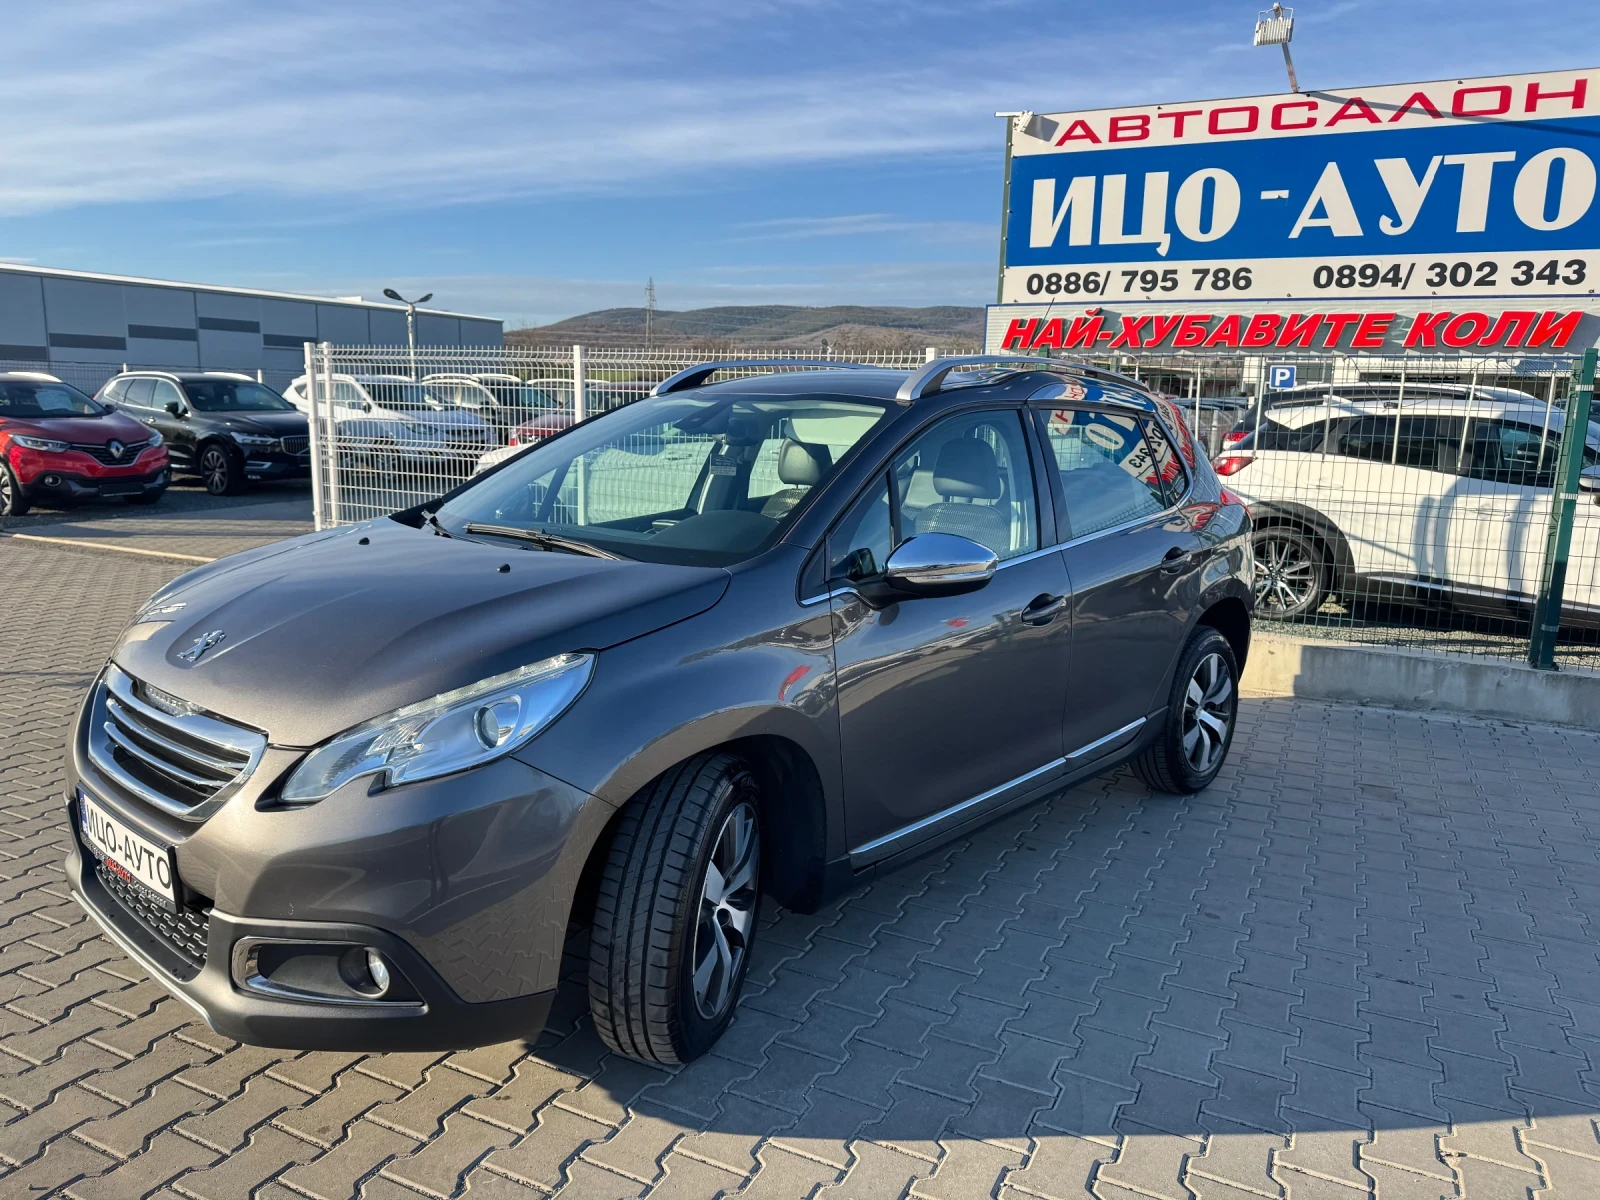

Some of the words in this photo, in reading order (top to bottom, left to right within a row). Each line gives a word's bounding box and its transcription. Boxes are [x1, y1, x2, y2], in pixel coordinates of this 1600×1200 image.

[1054, 78, 1588, 147] АВТОСАЛОН
[1026, 270, 1111, 296] 0886/
[1121, 269, 1179, 293] 795
[1191, 267, 1253, 291] 786
[1313, 262, 1416, 290] 0894/
[1425, 260, 1499, 288] 302
[1510, 259, 1587, 286] 343
[1000, 307, 1397, 350] НАЙ-ХУБАВИТЕ
[1401, 309, 1585, 348] КОЛИ
[1274, 368, 1291, 387] P
[86, 804, 172, 890] ИЦО-АУТО
